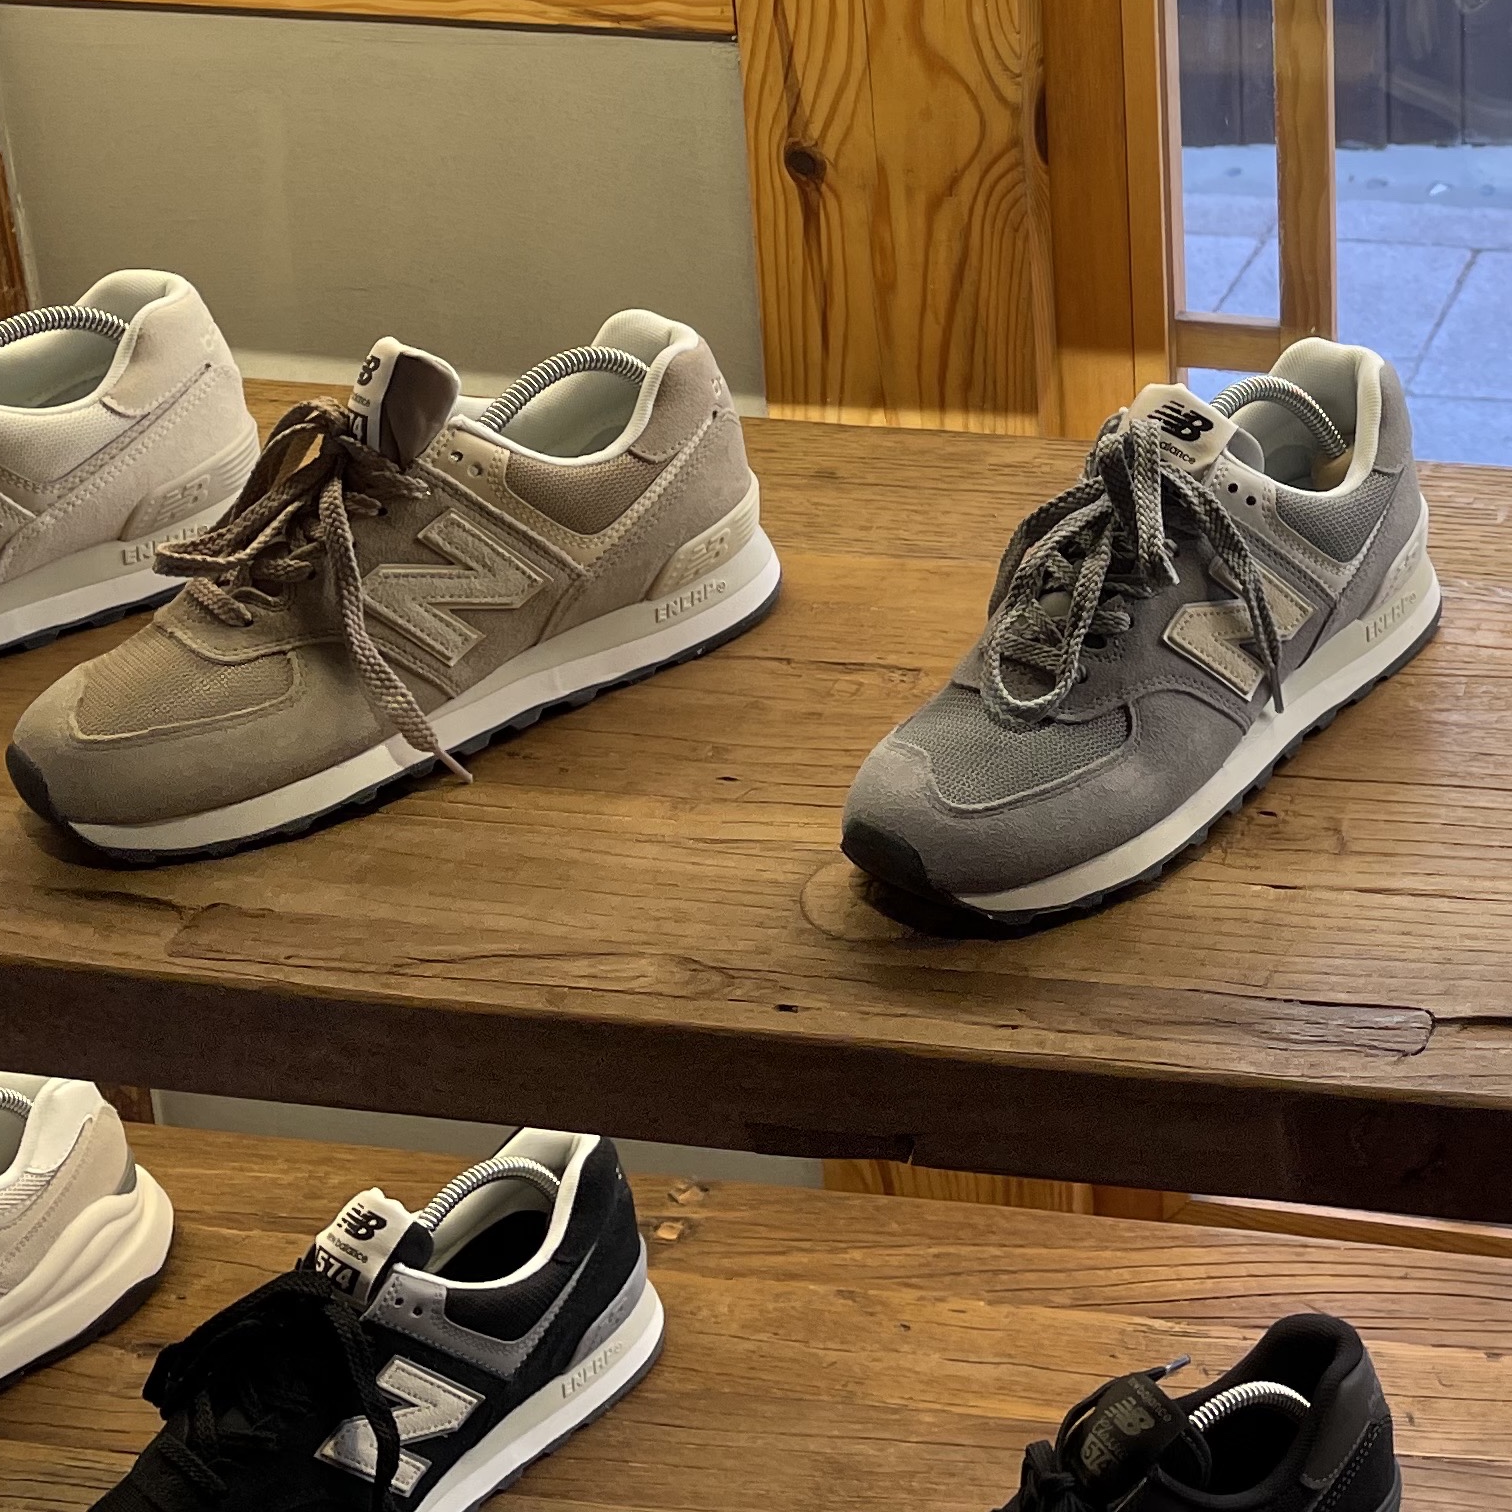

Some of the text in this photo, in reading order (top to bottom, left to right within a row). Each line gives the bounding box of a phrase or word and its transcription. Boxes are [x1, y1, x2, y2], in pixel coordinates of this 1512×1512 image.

[1159, 441, 1197, 465] alance
[336, 1202, 387, 1241] NB
[315, 1248, 353, 1289] 574
